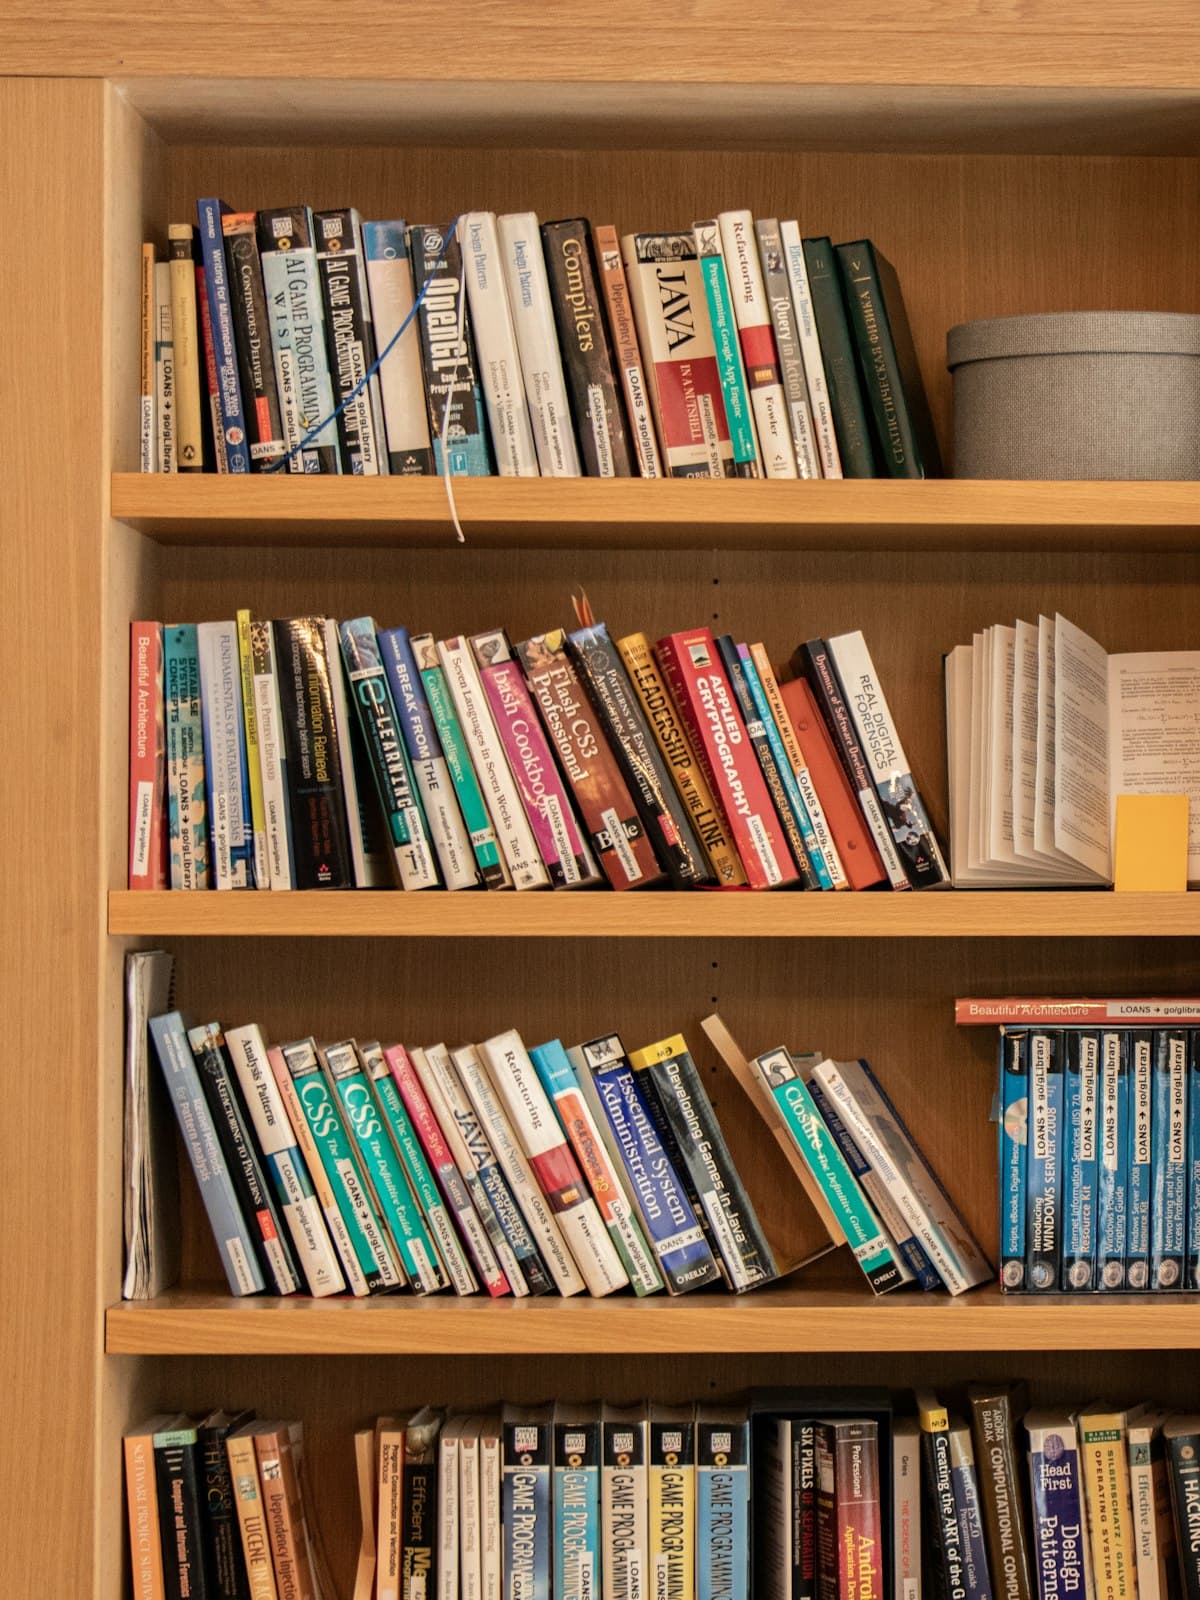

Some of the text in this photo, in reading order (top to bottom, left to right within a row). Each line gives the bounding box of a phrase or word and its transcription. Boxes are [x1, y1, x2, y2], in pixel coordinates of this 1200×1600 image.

[734, 222, 754, 302] Refactoring
[286, 258, 308, 321] AI GAME
[562, 239, 594, 352] Compilers
[656, 268, 696, 355] JAVA
[213, 249, 239, 417] Writing Multimedia Web
[241, 265, 264, 390] CONTINUOUS DELIVERY
[164, 360, 172, 398] LOANS
[280, 355, 291, 392] LOANS
[352, 347, 362, 385] LOANS
[629, 369, 643, 407] LOANS
[864, 290, 905, 464] СТАТИСТИЧЕСКАЯ ФИЗИКА
[765, 397, 778, 436] Fowler
[138, 637, 150, 757] Beautiful Architecture
[169, 659, 179, 722] CONCEPTS
[179, 658, 187, 704] SYSTEM
[220, 635, 233, 721] FUNDAMENTALS
[494, 671, 519, 715] bash
[225, 723, 234, 737] OF
[395, 665, 439, 789] BREAK FROM THE
[533, 676, 589, 783] Professional
[551, 667, 599, 758] Flash CS3
[709, 675, 742, 745] APPLIED
[854, 694, 888, 770] FORENSICS
[859, 674, 898, 767] REAL DIGITAL
[226, 739, 237, 791] DATABASE
[317, 736, 330, 783] Retrieval
[452, 658, 513, 830] Seven Languages in Weeks
[633, 664, 725, 852] LEADERSHIP THE LINE
[696, 677, 751, 816] CRYPTOGRAPHY
[180, 773, 188, 811] LOANS
[548, 799, 561, 829] LOANS
[799, 770, 817, 806] LOANS
[229, 792, 240, 842] SYSTEMS
[510, 838, 521, 858] Tate
[970, 1004, 1088, 1016] Beautiful Architecture
[241, 1038, 276, 1126] Analysis Patterns
[505, 1052, 542, 1131] Refactoring
[301, 1082, 339, 1137] CSS
[345, 1083, 383, 1139] CSS
[668, 1063, 725, 1189] Developing Games
[427, 1129, 443, 1157] Style
[600, 1081, 661, 1220] Administration
[616, 1072, 686, 1226] Essential System
[1037, 1116, 1045, 1156] LOANS
[1084, 1119, 1092, 1157] LOANS
[1107, 1118, 1115, 1156] LOANS
[1138, 1124, 1147, 1161] LOANS
[1174, 1121, 1182, 1161] LOANS
[282, 1163, 299, 1197] LOANS
[344, 1171, 365, 1209] LOANS
[1044, 1141, 1056, 1251] WINDOWS SERVER
[433, 1211, 450, 1242] LOANS
[610, 1202, 629, 1229] LOANS
[802, 1427, 813, 1487] SIX PIXELS
[852, 1445, 863, 1498] Professional
[1040, 1463, 1071, 1477] Head
[513, 1474, 536, 1511] GAME
[563, 1474, 587, 1508] GAME
[611, 1475, 634, 1508] GAME
[661, 1474, 684, 1507] GAME
[711, 1474, 732, 1508] GAME
[936, 1437, 959, 1562] Creating the ART of
[991, 1447, 1012, 1554] COMPUTATIONAL
[1042, 1477, 1071, 1491] First
[245, 1516, 266, 1564] LUCENE
[270, 1494, 288, 1550] Dependency
[1095, 1451, 1112, 1580] OPERATING SYSTEM
[1061, 1524, 1080, 1591] Design
